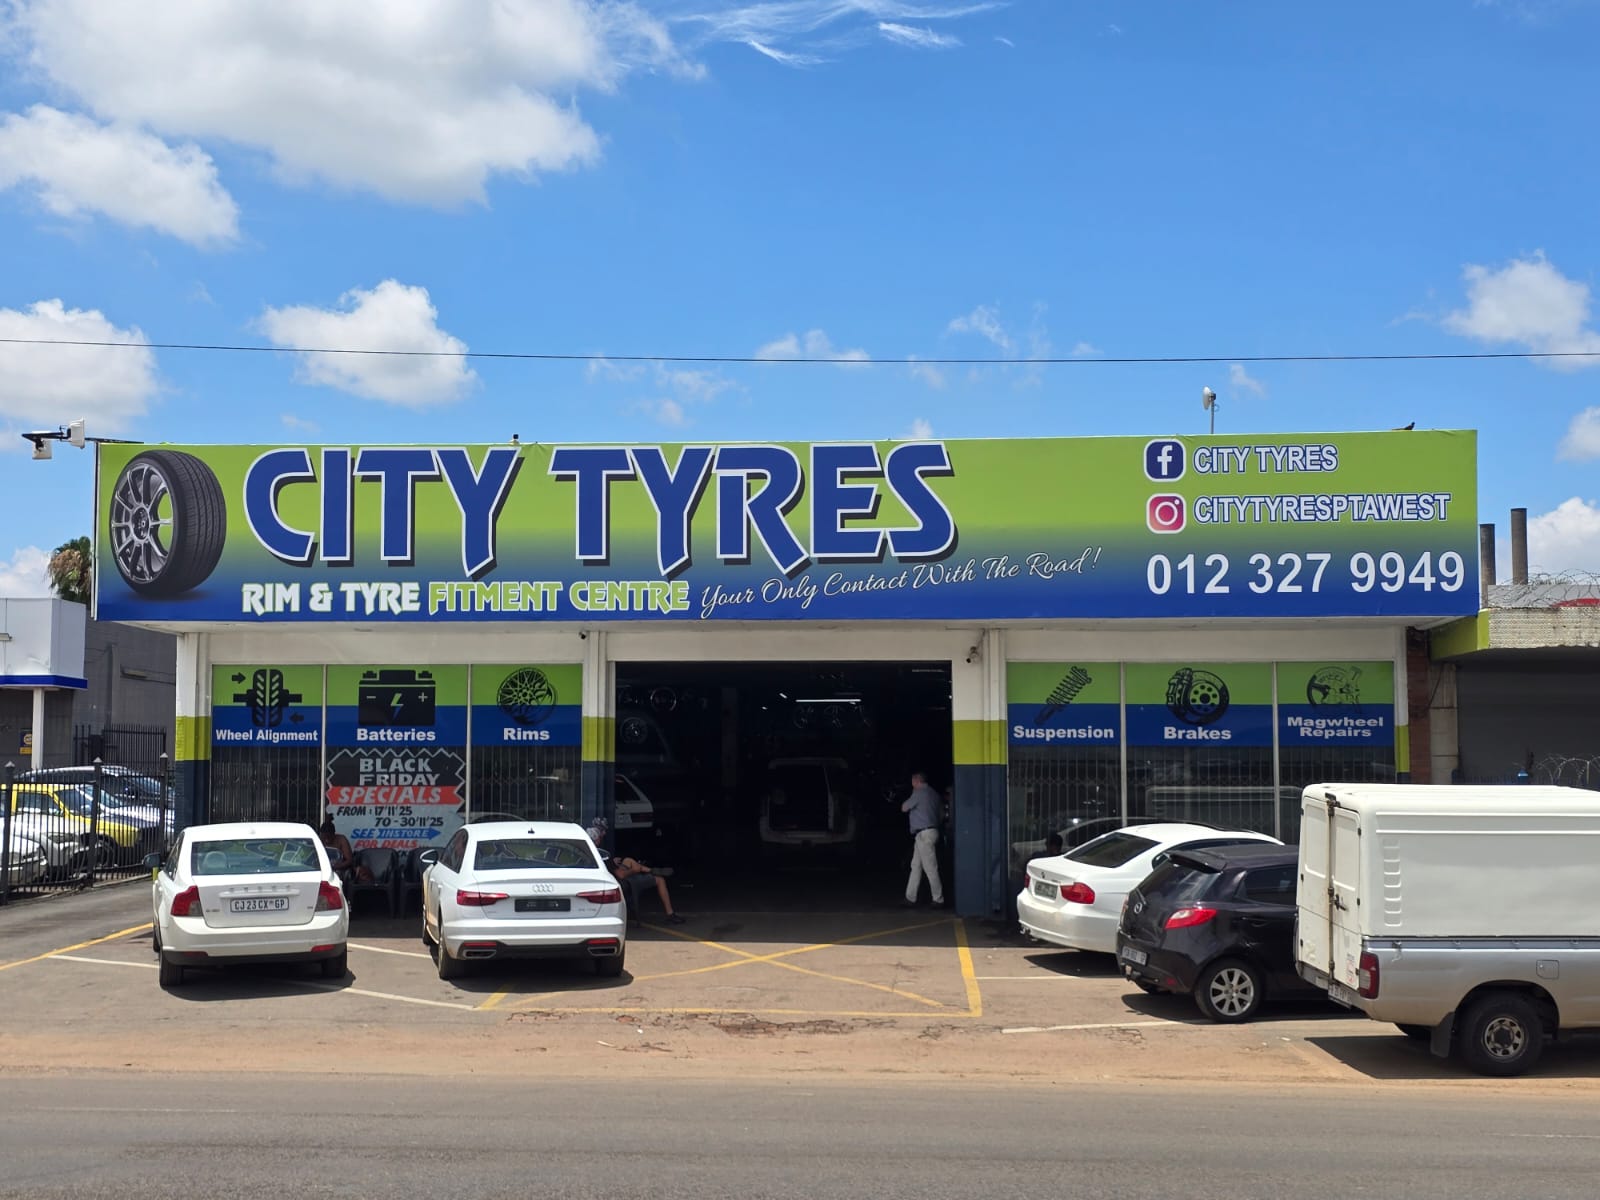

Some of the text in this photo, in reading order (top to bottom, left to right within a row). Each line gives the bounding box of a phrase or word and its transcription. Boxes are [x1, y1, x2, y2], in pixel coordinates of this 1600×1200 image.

[1193, 444, 1339, 473] CITY TYRES
[242, 442, 957, 578] CITY TYRES
[1194, 493, 1451, 523] CITYTYRESPTAWEST
[1147, 551, 1465, 595] 012 327 9949
[700, 584, 755, 620] Your
[761, 575, 819, 610] Only
[823, 571, 909, 597] Contact
[912, 558, 976, 589] With
[981, 555, 1020, 580] The
[242, 580, 691, 616] RIM & TYRE FITMENT CENTRE
[1287, 716, 1384, 729] Magwheel
[215, 729, 319, 744] Wheel Alignment
[356, 728, 436, 742] Batteries
[503, 727, 550, 742] Rims
[1013, 725, 1115, 741] Suspension
[1163, 725, 1232, 741] Brakes
[1300, 727, 1372, 739] Repairs
[359, 758, 433, 773] BLACK
[359, 773, 441, 786] FRIDAY
[338, 786, 442, 804] SPECIALS
[375, 817, 392, 827] TO
[351, 828, 429, 840] SEE INSTORE
[354, 839, 378, 848] FOR
